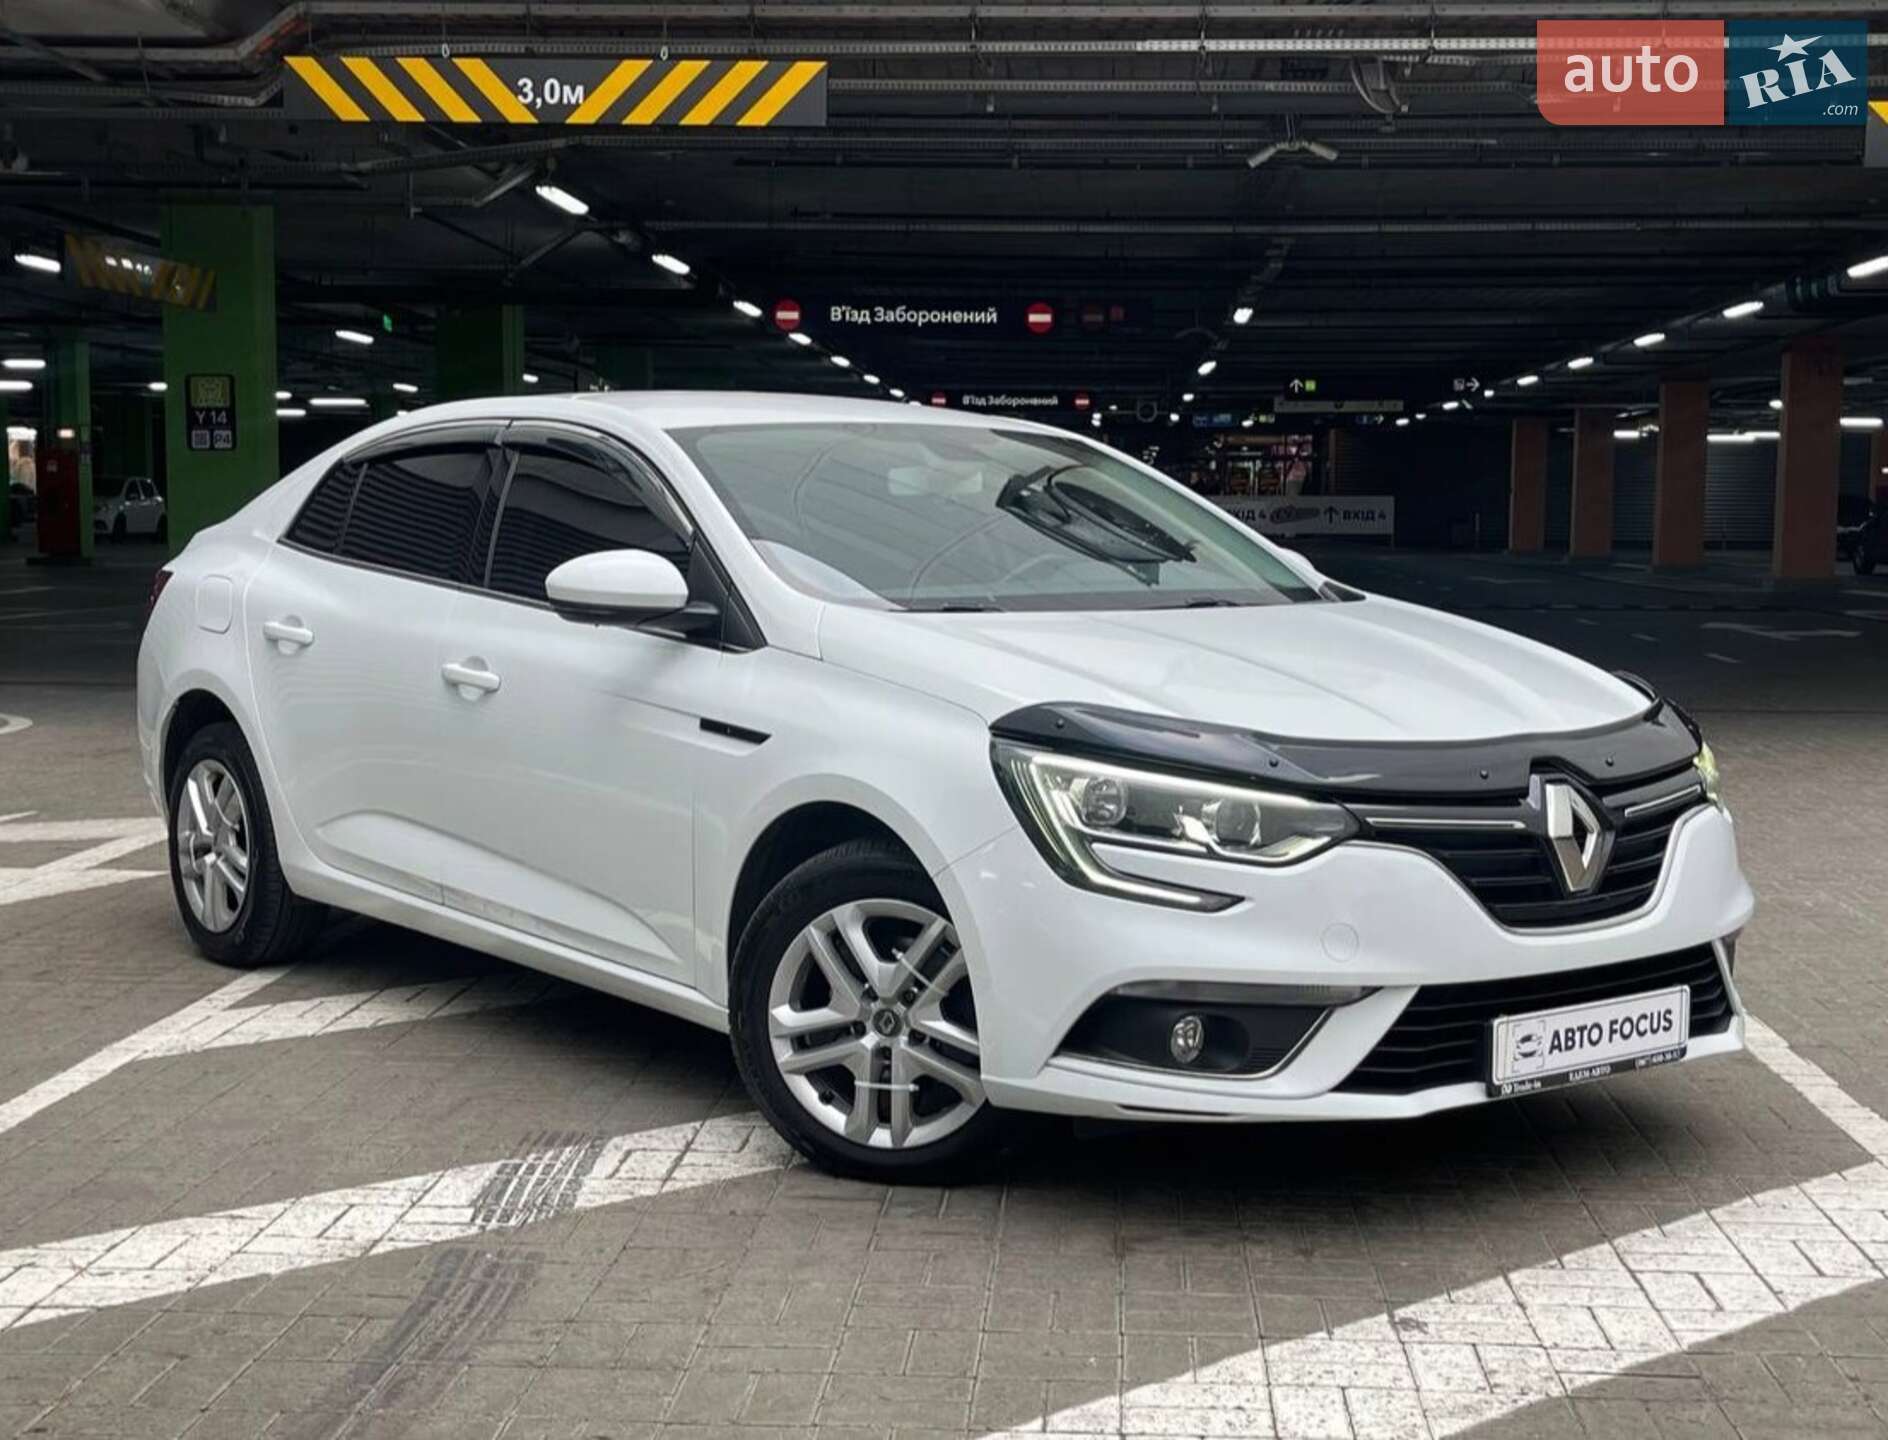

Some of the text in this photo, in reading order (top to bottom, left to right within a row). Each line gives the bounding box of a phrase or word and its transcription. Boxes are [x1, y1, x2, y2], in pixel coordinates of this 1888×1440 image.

[830, 305, 998, 327] В'їзд Заборонений
[210, 410, 228, 424] 14
[1228, 508, 1256, 521] ХІД
[1548, 1008, 1673, 1055] АВТО FOCUS
